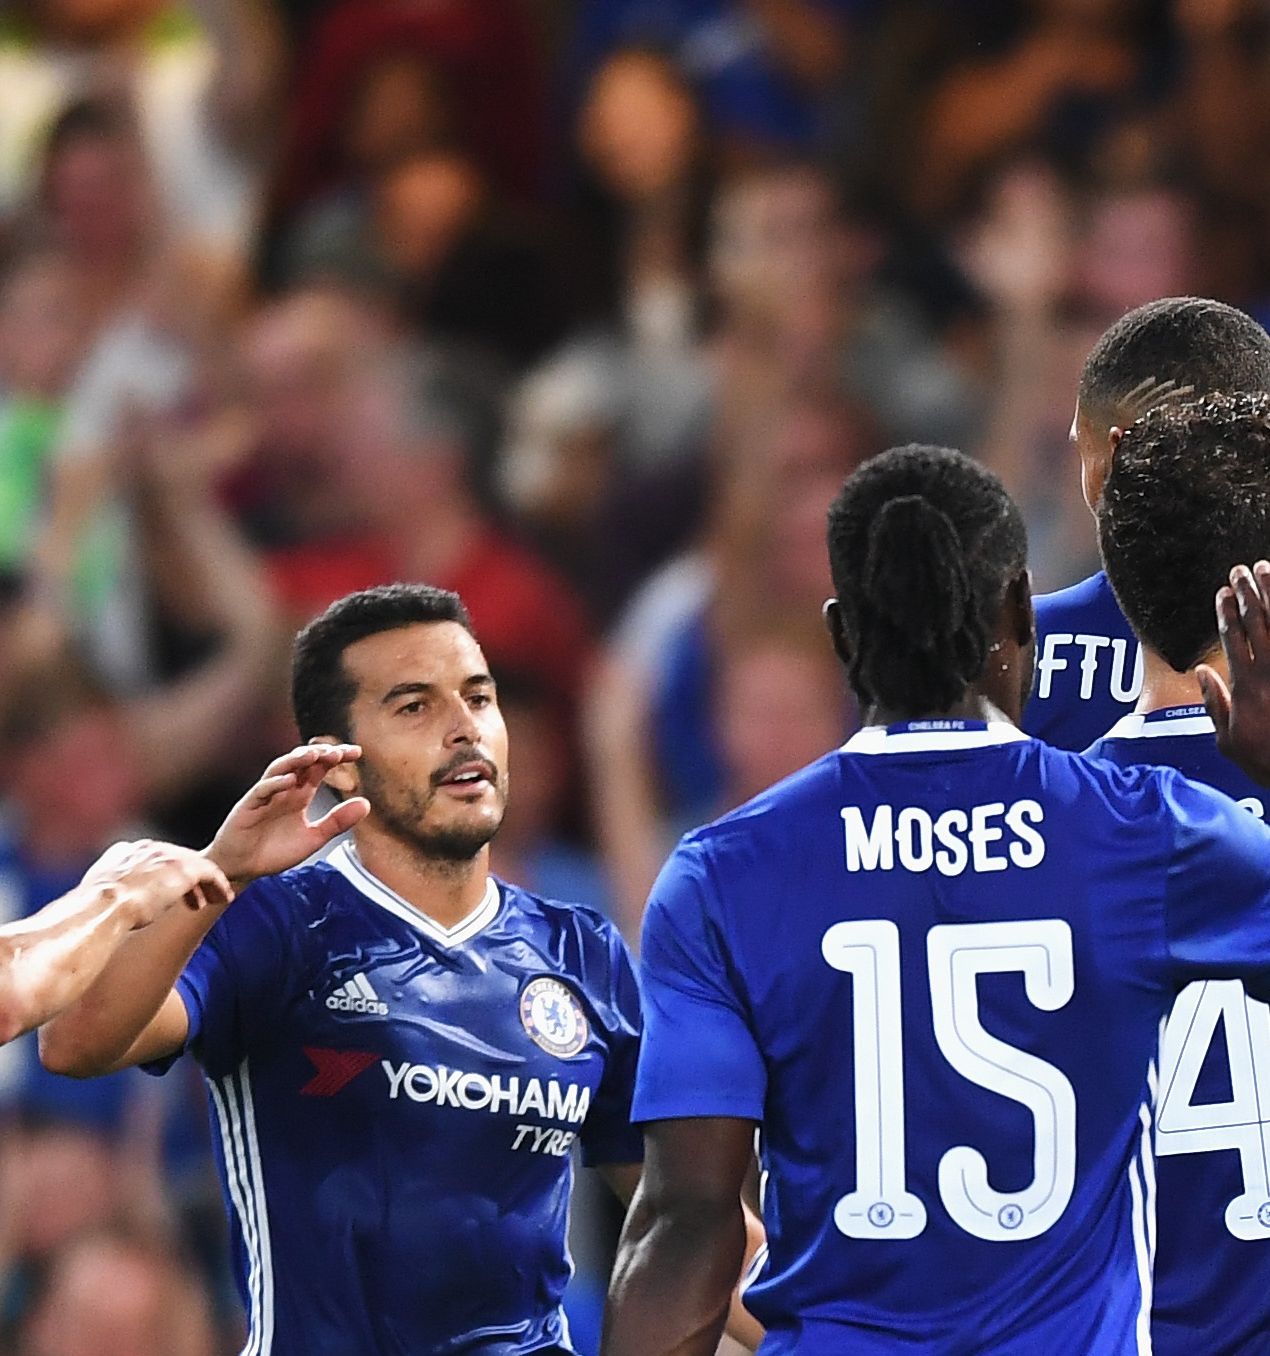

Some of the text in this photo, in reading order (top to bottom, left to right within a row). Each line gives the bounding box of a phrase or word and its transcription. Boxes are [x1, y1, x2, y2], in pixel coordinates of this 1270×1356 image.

[840, 799, 1046, 877] MOSES
[325, 996, 389, 1016] adidas
[381, 1060, 591, 1125] YOKOHAMA
[821, 918, 1077, 1242] 15
[511, 1124, 577, 1158] TYRE
